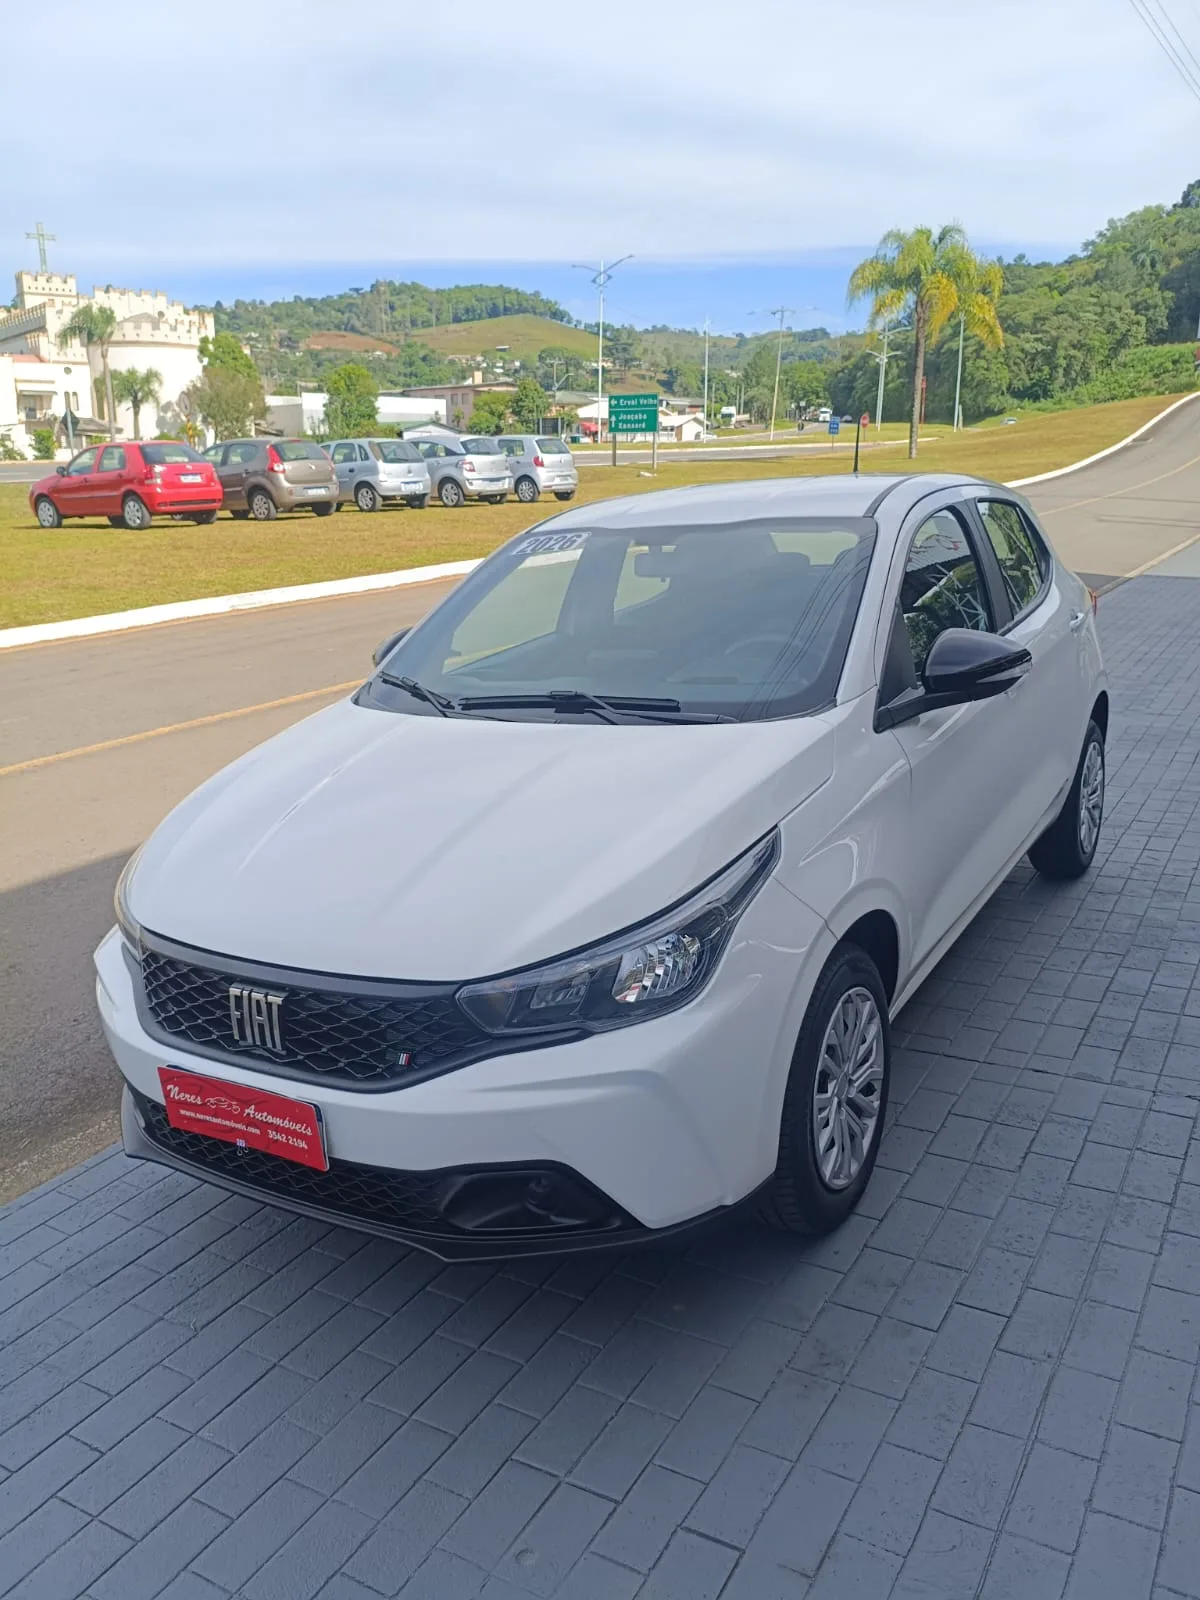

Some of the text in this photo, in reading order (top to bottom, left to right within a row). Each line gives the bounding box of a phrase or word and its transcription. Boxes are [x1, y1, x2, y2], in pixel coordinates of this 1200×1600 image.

[620, 397, 657, 406] Erval Velho
[516, 532, 584, 554] 2026
[228, 987, 284, 1051] FIAT
[166, 1084, 313, 1136] Neres Automóveis
